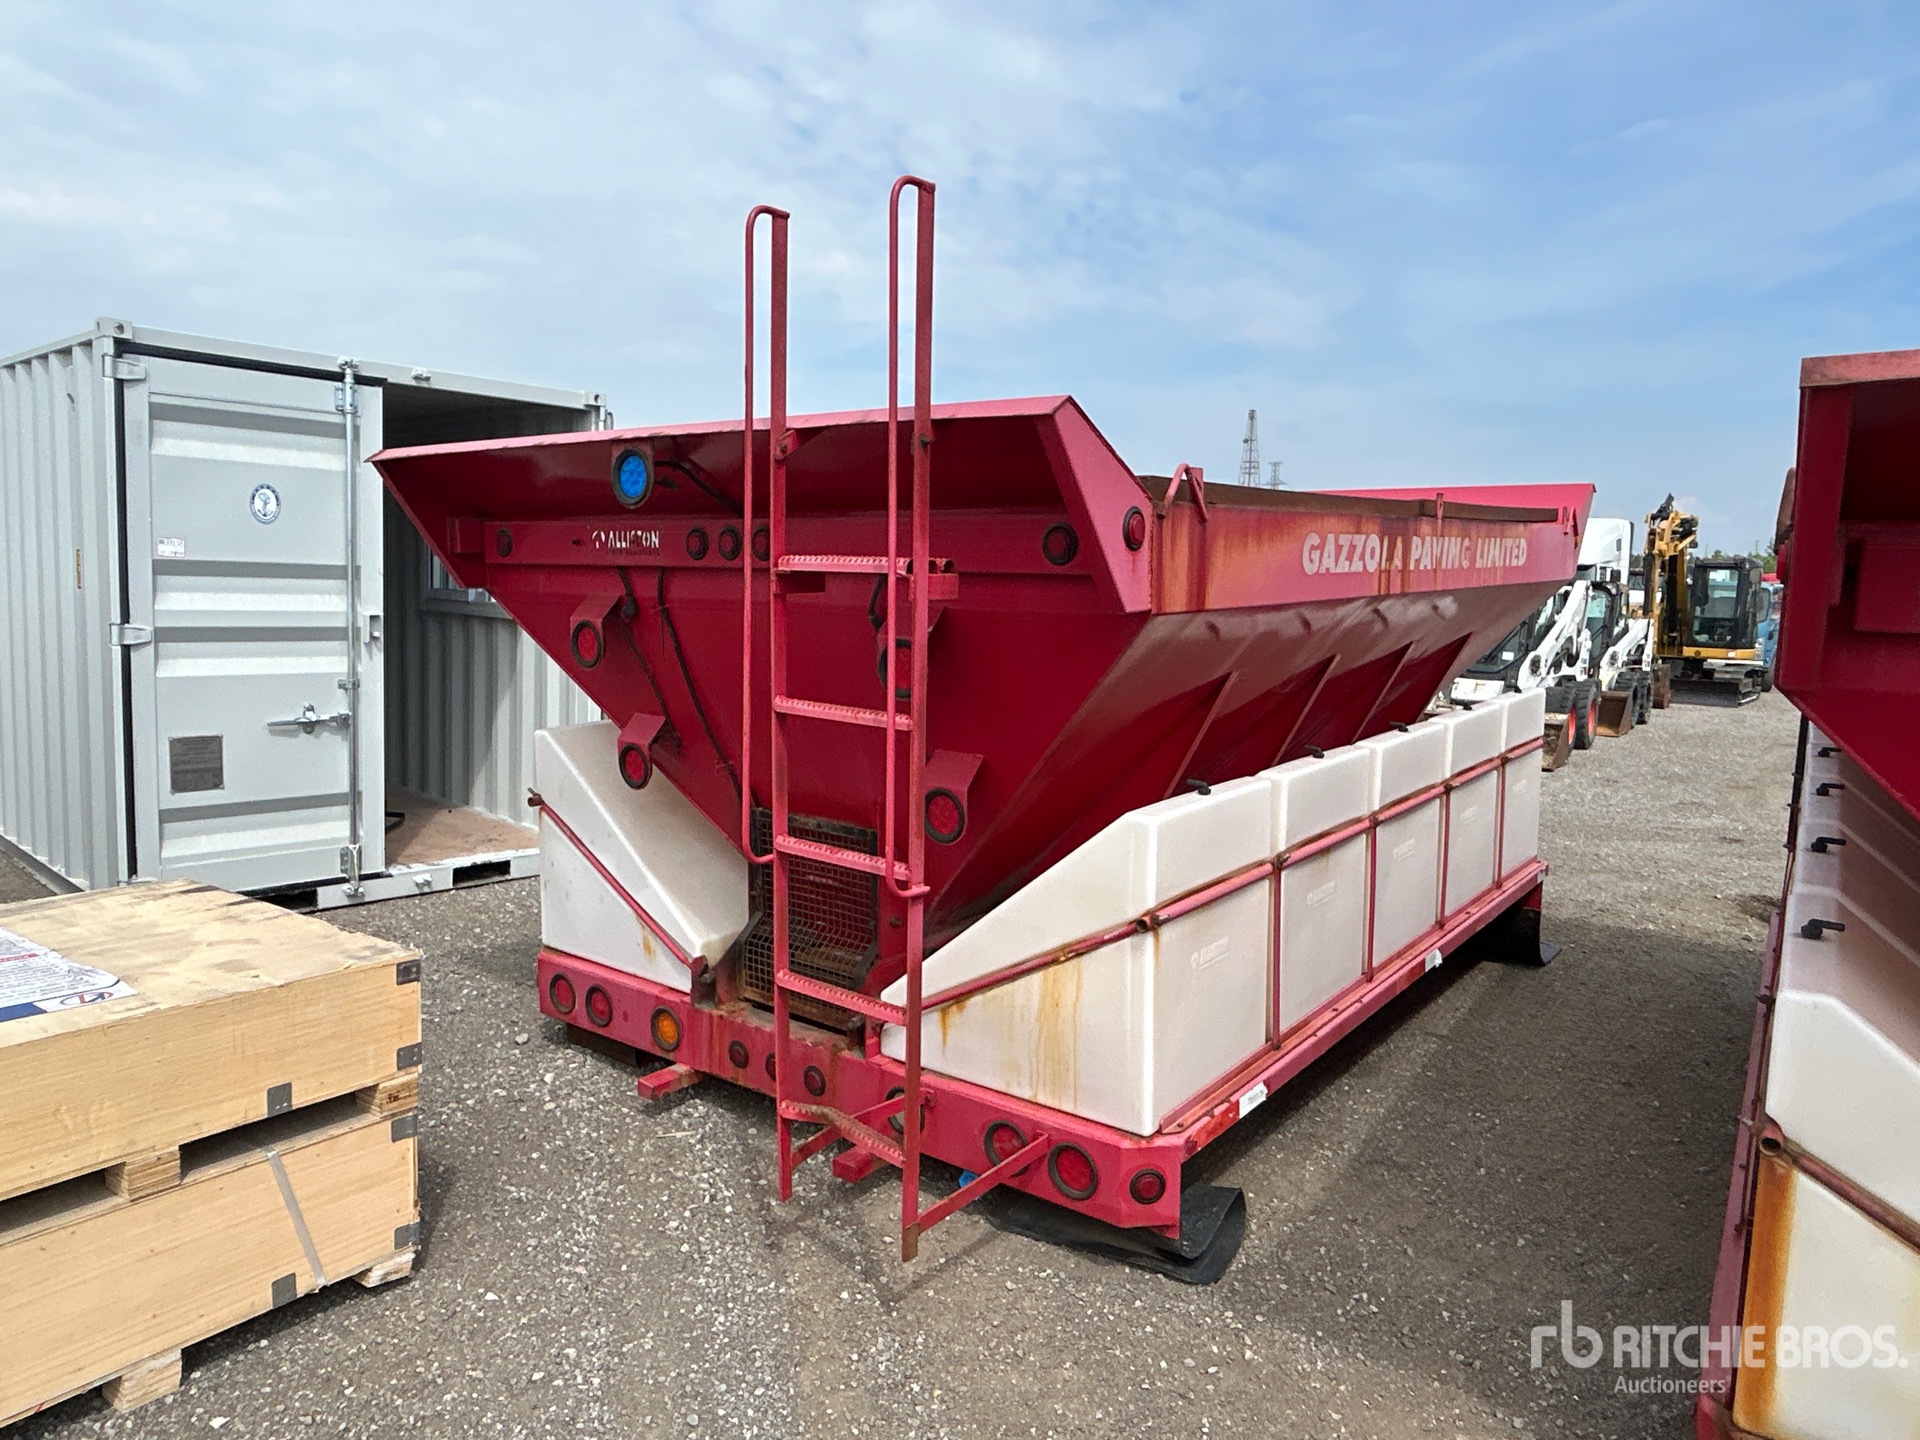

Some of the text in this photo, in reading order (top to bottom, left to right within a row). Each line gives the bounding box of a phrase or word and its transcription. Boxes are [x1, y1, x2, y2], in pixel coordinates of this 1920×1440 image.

[1302, 532, 1528, 575] GAZZOLA PAVING LIMITED
